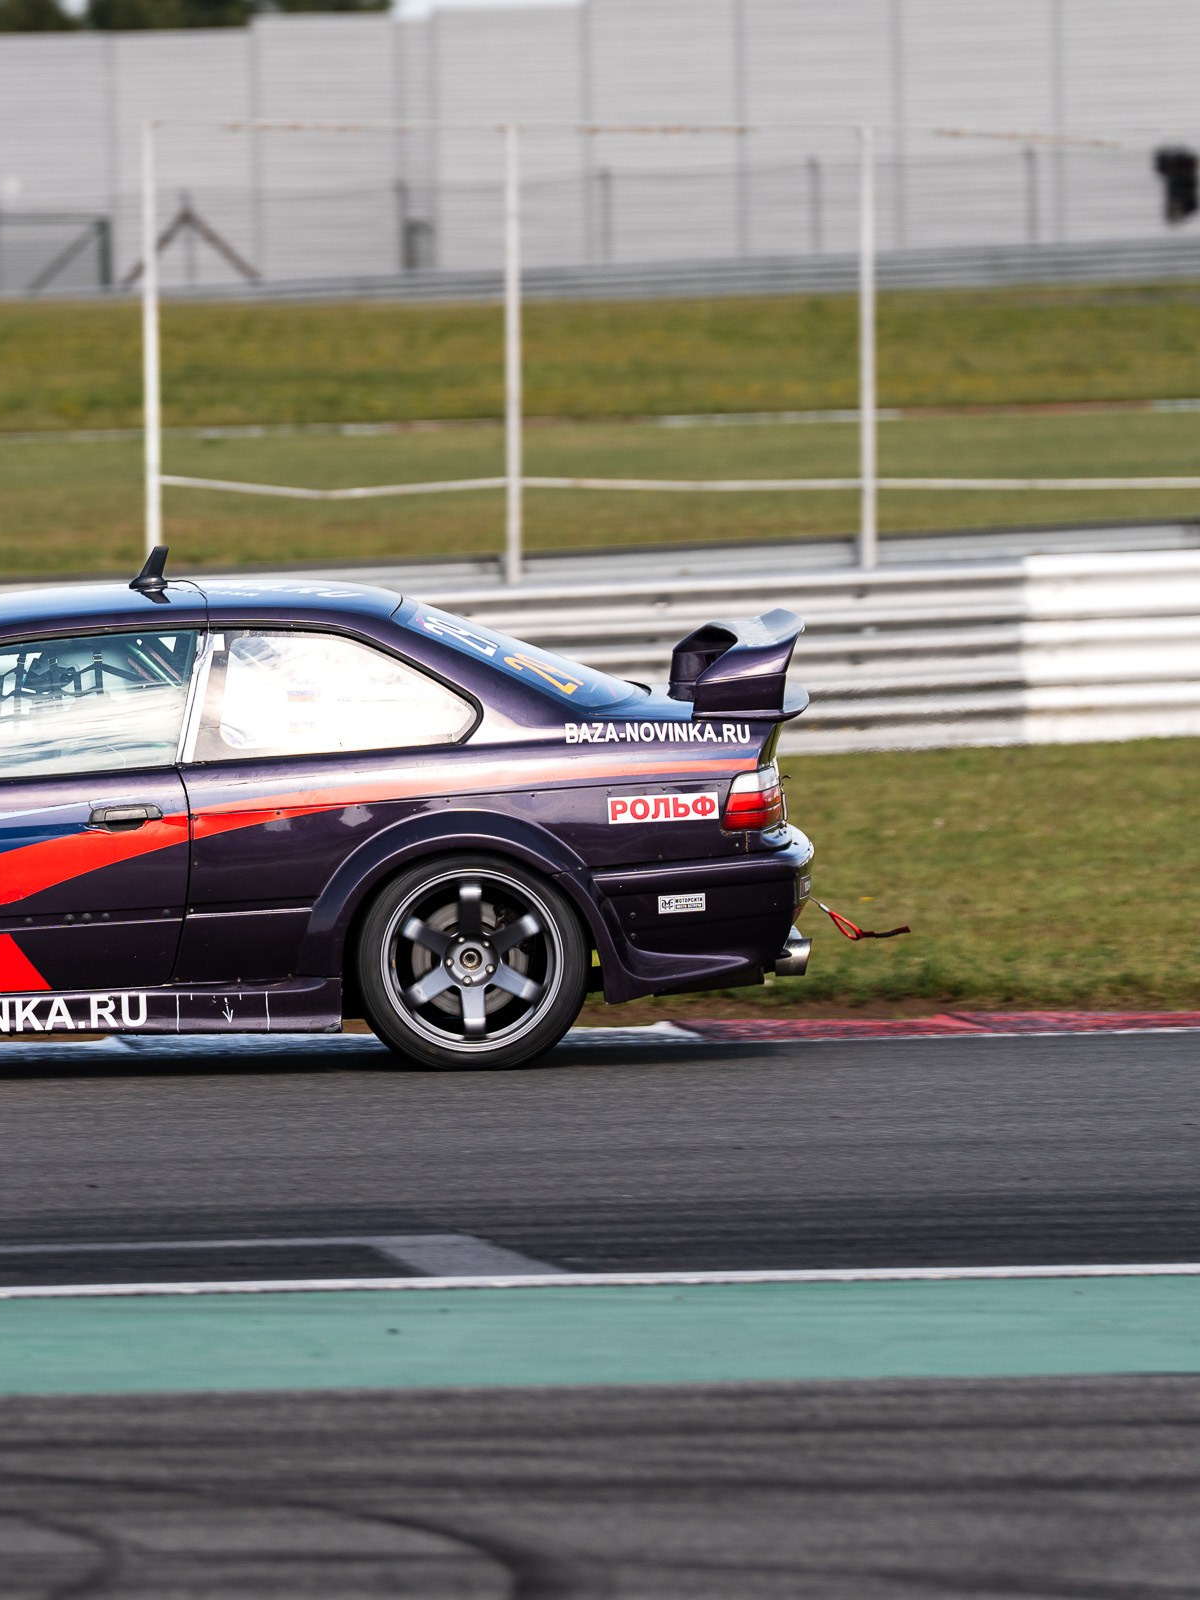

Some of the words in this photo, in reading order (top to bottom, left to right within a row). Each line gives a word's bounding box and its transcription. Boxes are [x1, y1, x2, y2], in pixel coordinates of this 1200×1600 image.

[423, 616, 499, 657] 29
[564, 722, 751, 745] BAZA-NOVINKA.RU
[610, 796, 716, 821] РОЛЬФ
